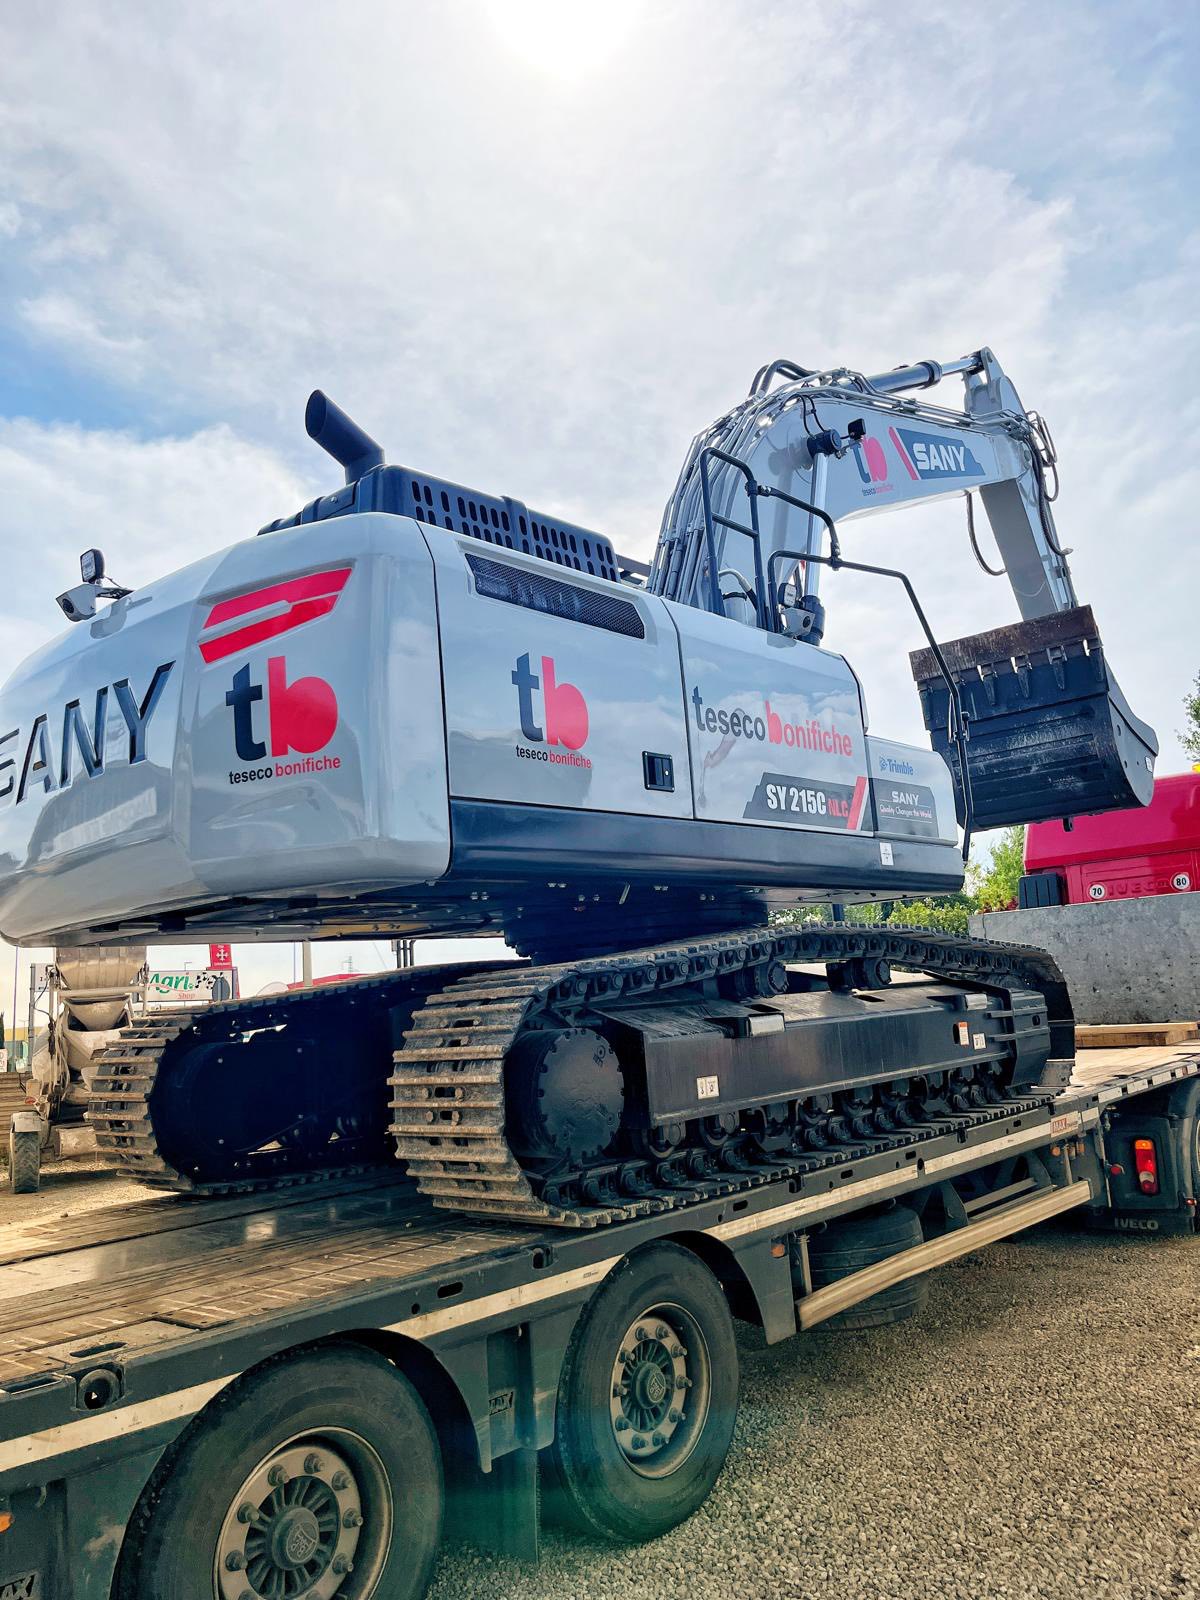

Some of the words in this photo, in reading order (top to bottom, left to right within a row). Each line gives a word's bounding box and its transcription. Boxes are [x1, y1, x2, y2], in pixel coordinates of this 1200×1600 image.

[912, 442, 966, 472] SANY
[225, 655, 339, 762] tb
[511, 651, 590, 751] tb
[692, 685, 767, 742] teseco
[765, 699, 853, 757] bonifiche
[515, 744, 549, 762] teseco
[549, 750, 592, 769] bonifiche
[887, 758, 914, 776] Trimble
[228, 766, 273, 785] teseco
[275, 755, 341, 778] bonifiche
[766, 783, 787, 811] SY
[789, 787, 827, 816] 215C
[827, 797, 849, 818] NLC
[879, 804, 895, 815] Quality
[891, 790, 919, 806] SANY
[1092, 887, 1103, 896] 70
[1175, 877, 1187, 887] 80
[147, 971, 190, 994] Agri
[1114, 1217, 1159, 1230] IVECO
